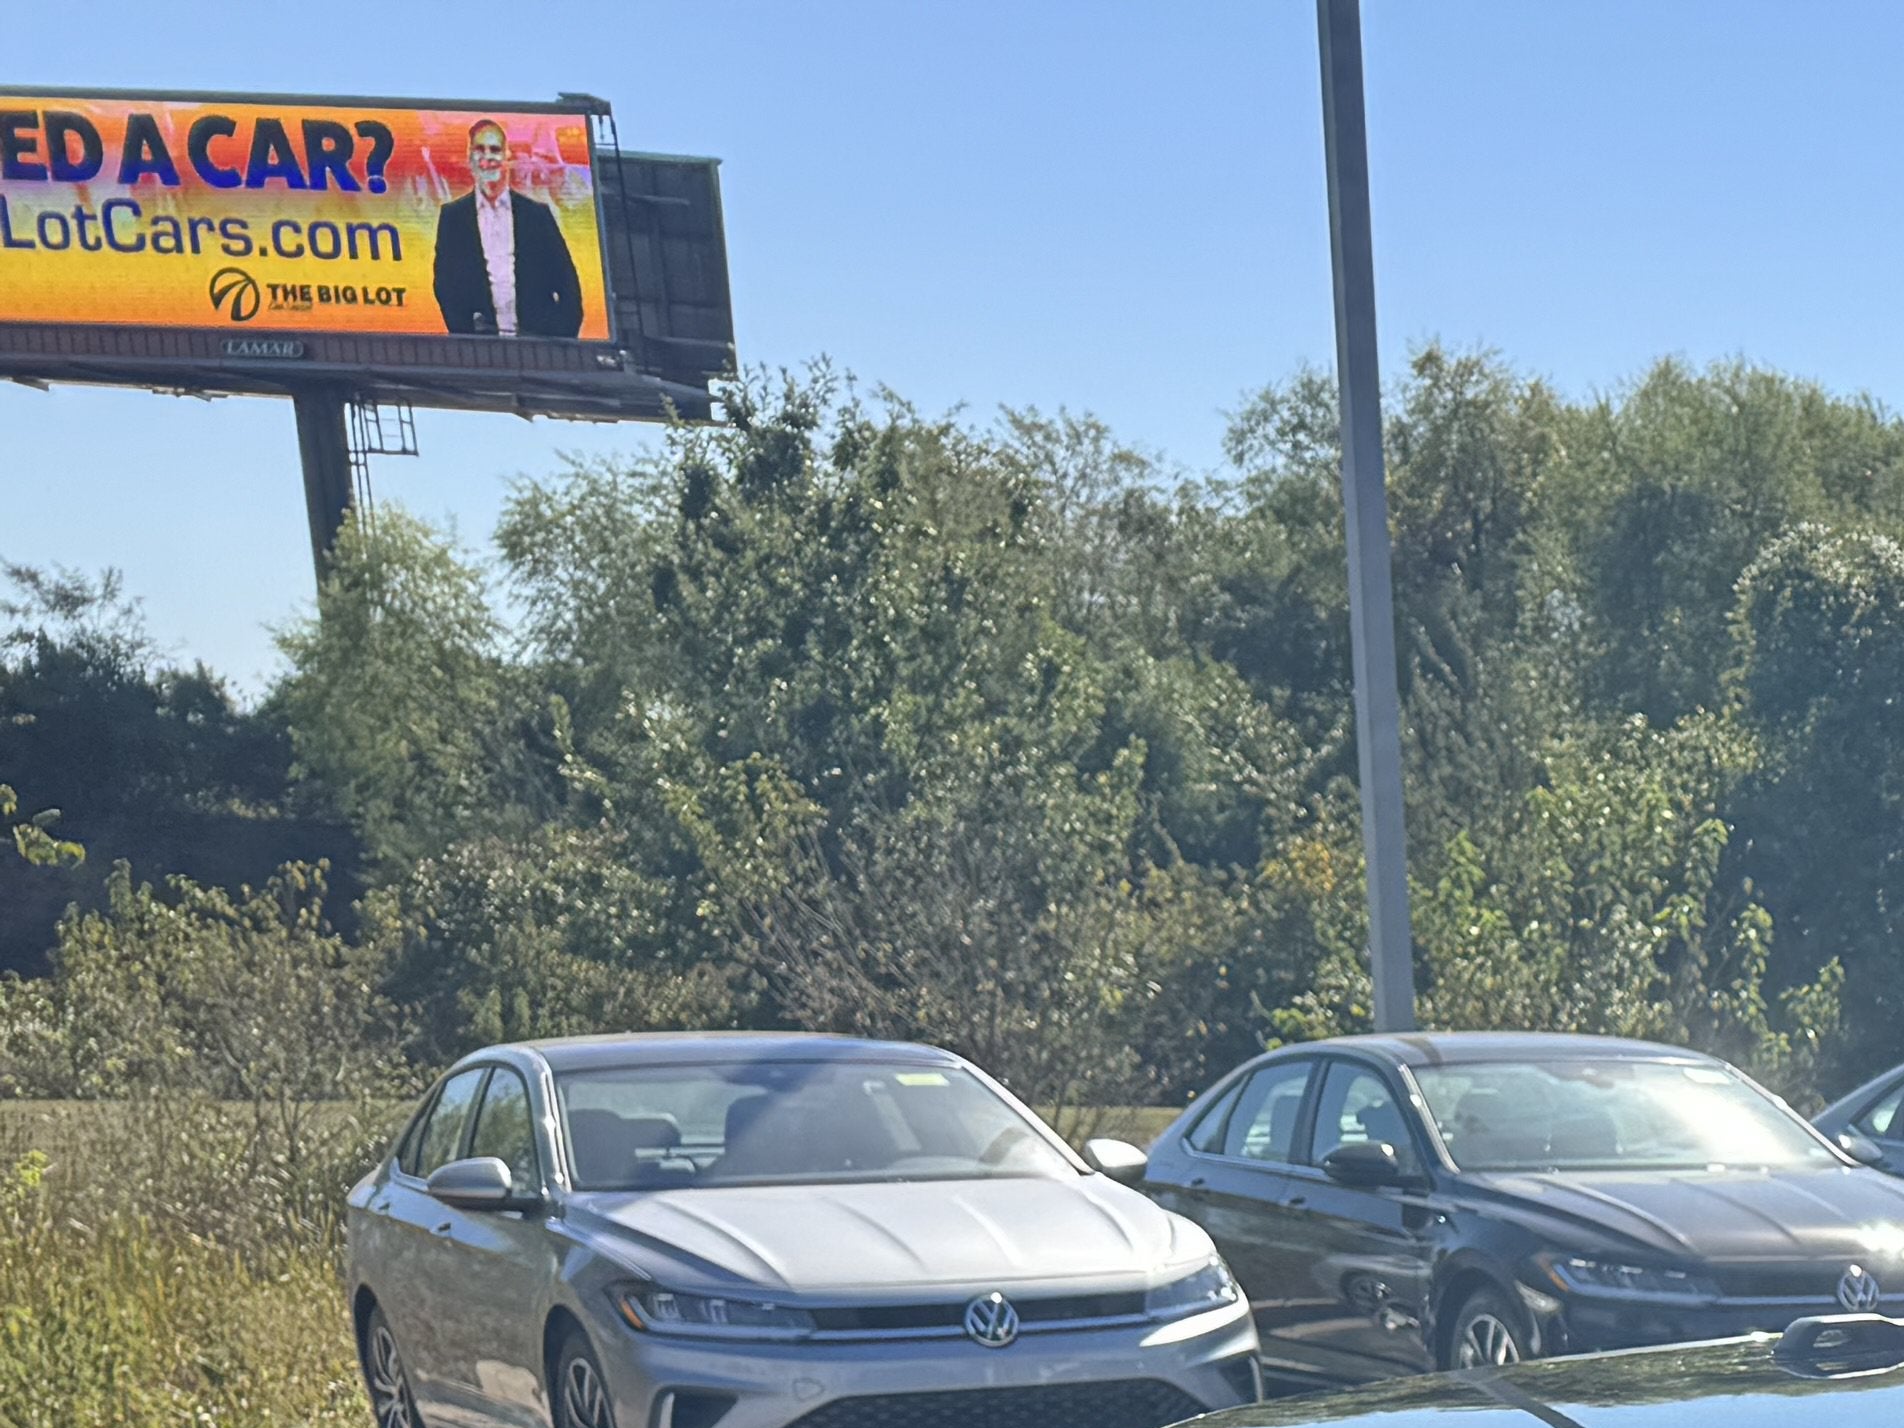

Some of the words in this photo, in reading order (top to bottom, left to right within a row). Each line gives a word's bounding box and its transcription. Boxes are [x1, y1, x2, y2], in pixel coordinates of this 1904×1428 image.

[0, 110, 104, 182] ED
[118, 113, 181, 186] A
[187, 114, 394, 194] CAR?
[0, 193, 402, 261] LotCars.com
[266, 283, 313, 304] THE
[317, 285, 358, 304] BIG
[362, 286, 406, 308] LOT
[226, 340, 295, 356] LAMAR
